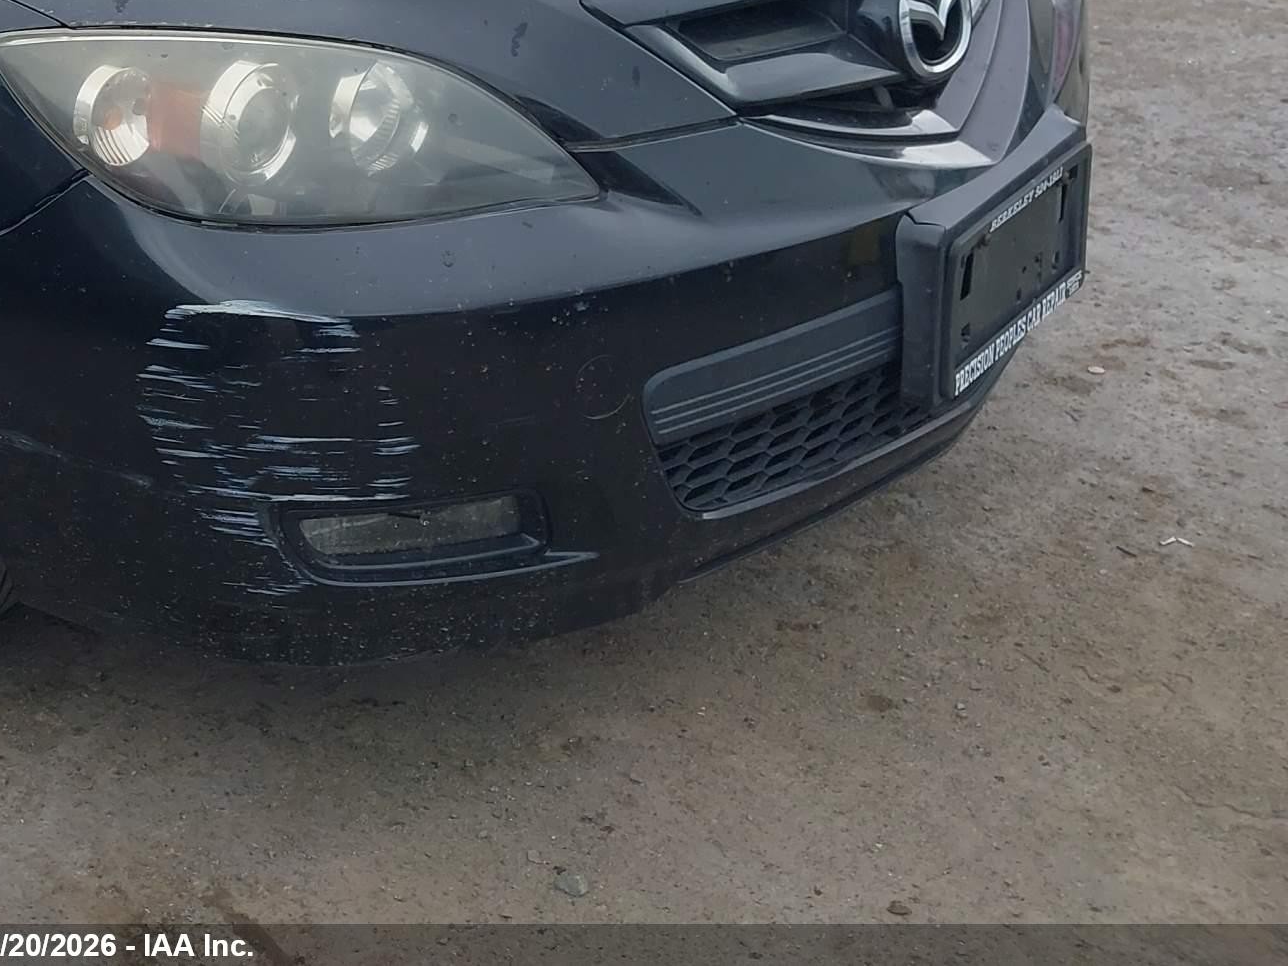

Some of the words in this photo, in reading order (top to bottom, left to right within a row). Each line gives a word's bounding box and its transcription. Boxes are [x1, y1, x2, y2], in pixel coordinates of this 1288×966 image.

[989, 189, 1034, 234] BERKELEY
[955, 342, 995, 397] PRECISION
[995, 314, 1028, 362] PEOPLES
[1027, 302, 1042, 333] CAR
[1042, 281, 1066, 322] REPAIR
